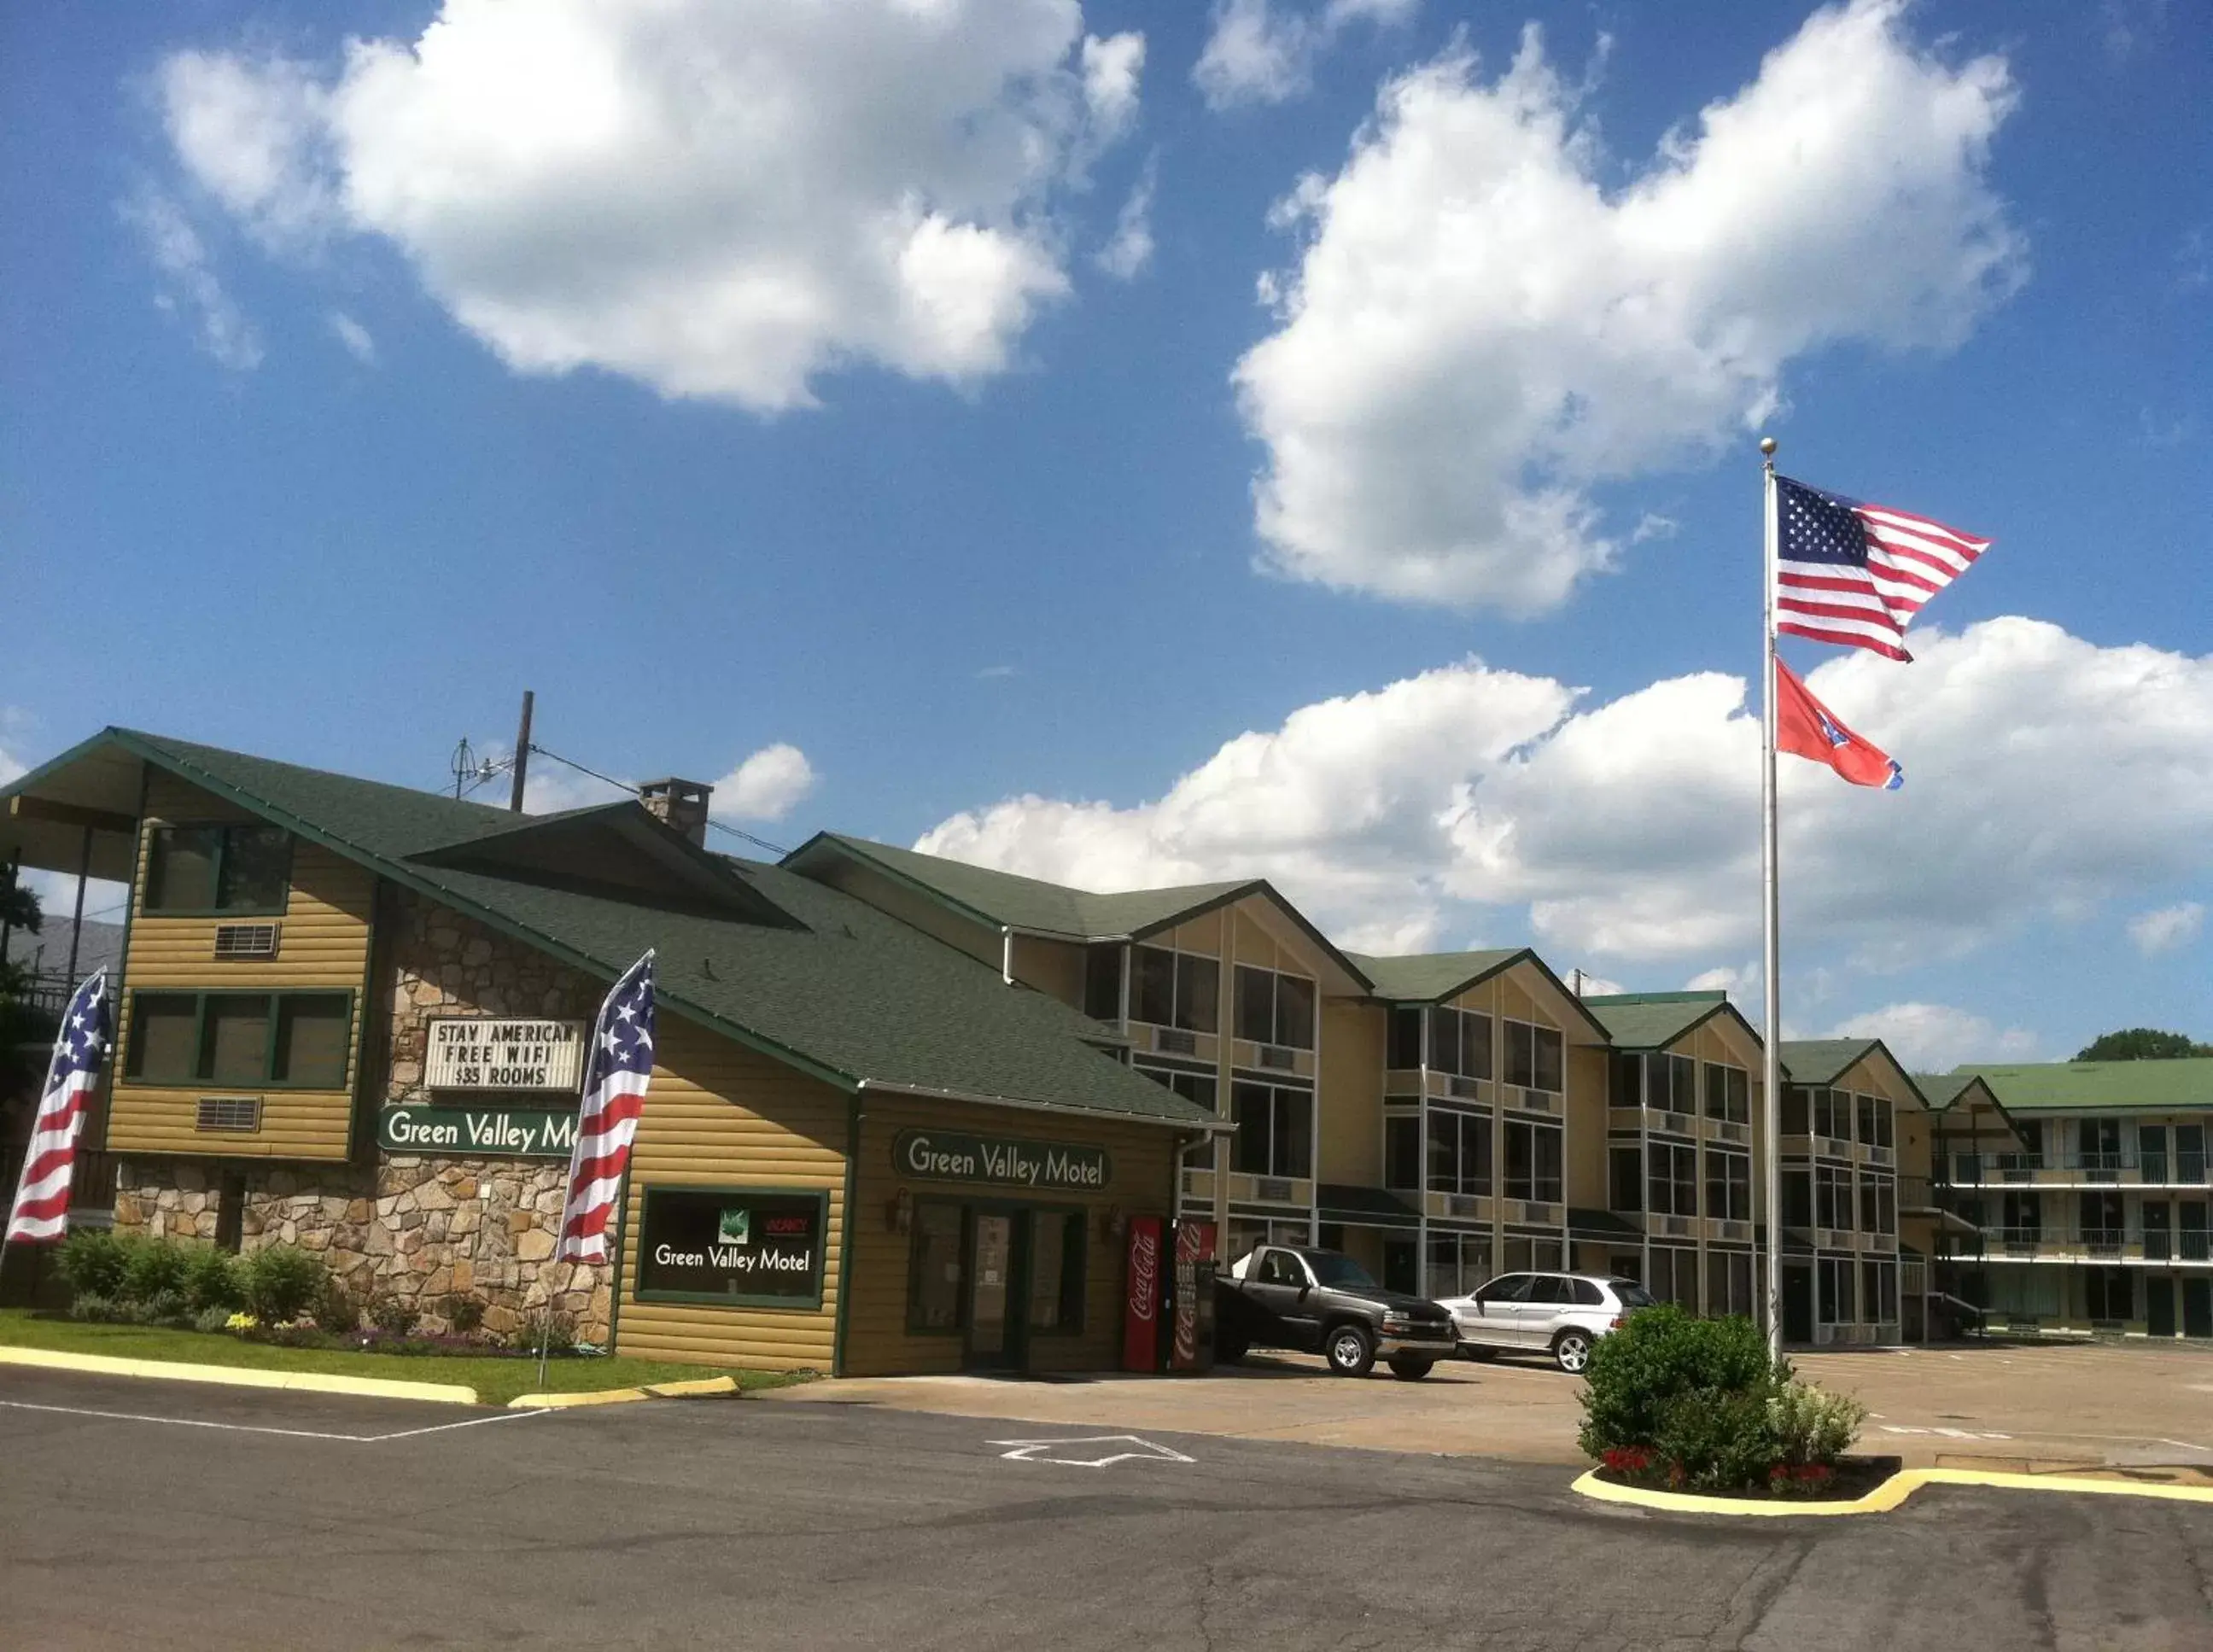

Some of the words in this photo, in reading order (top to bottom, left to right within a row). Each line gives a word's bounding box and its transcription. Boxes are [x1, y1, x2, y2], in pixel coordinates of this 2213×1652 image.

[437, 1024, 480, 1042] STAY
[490, 1024, 574, 1043] AMERICAN
[445, 1045, 493, 1064] FREE
[506, 1046, 552, 1064] WIFI
[455, 1066, 481, 1085] $35
[488, 1067, 546, 1085] ROOMS
[388, 1110, 458, 1144] Green
[465, 1113, 537, 1153] Valley
[908, 1136, 976, 1176] Green
[980, 1142, 1042, 1186] Valley
[1045, 1148, 1103, 1185] Motel
[655, 1243, 704, 1267] Green
[708, 1245, 756, 1273] Valley
[760, 1247, 810, 1272] Motel
